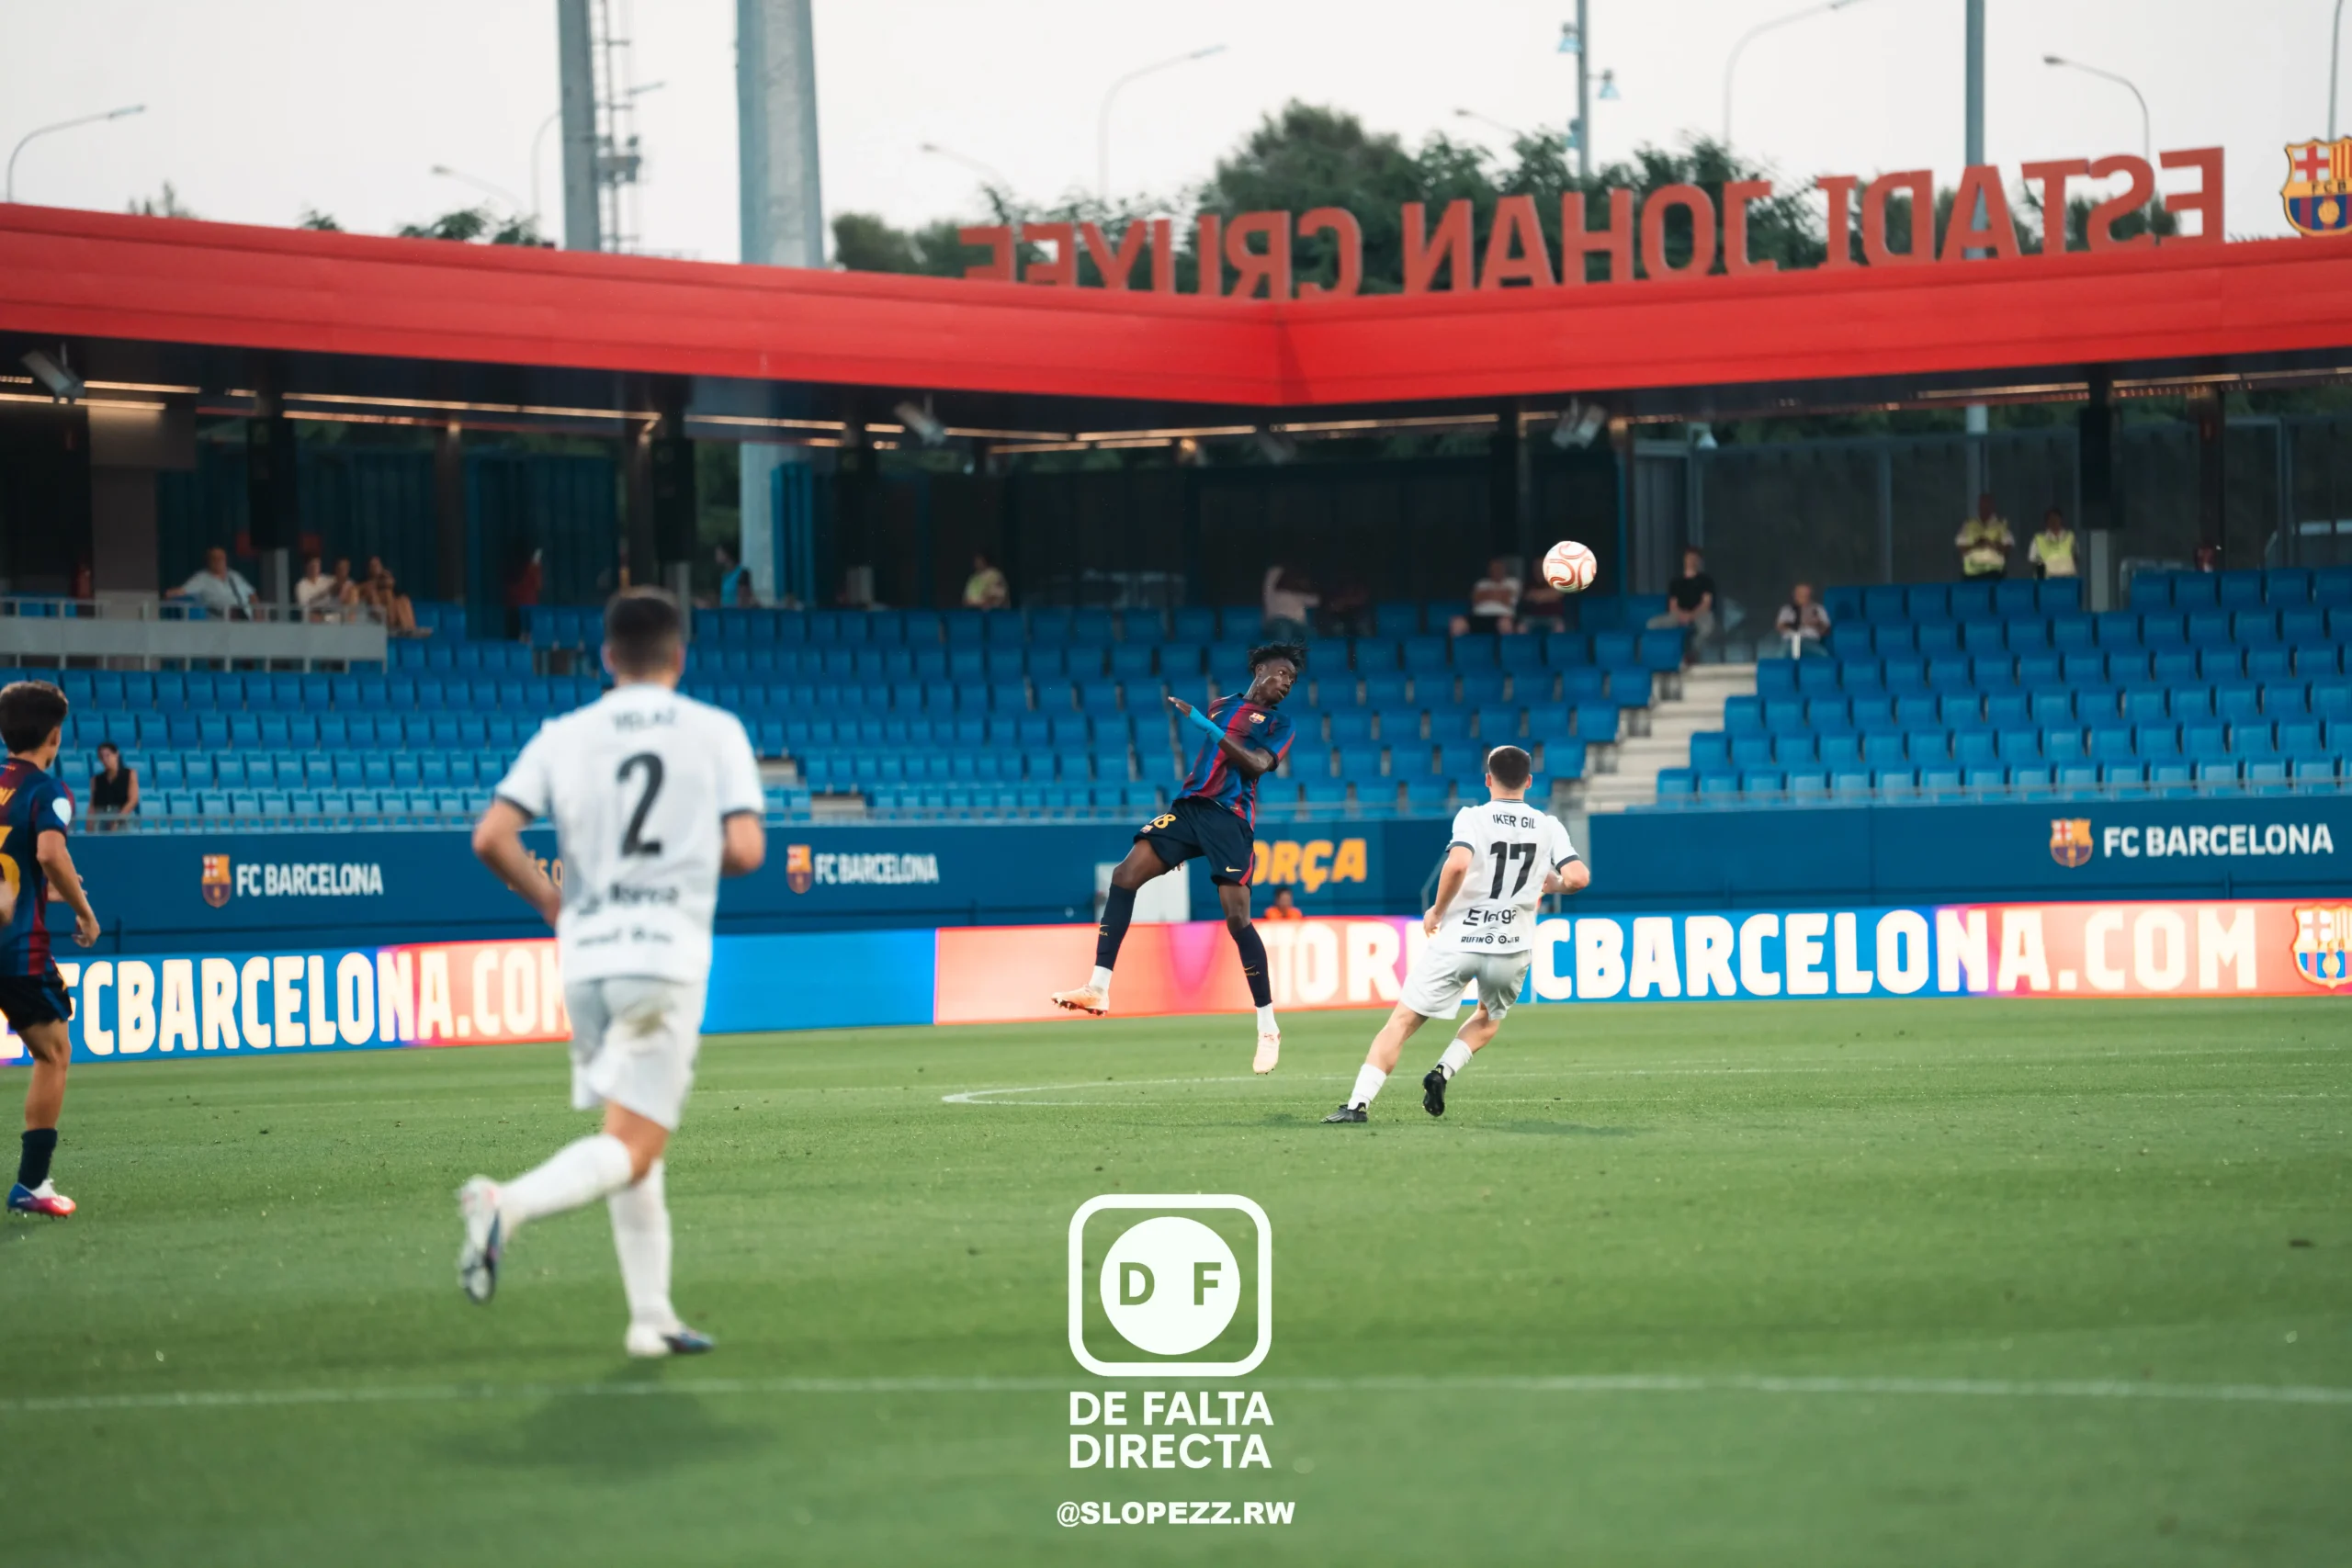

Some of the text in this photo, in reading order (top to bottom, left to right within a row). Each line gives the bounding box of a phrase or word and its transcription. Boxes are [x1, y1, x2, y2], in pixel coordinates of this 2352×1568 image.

[616, 750, 664, 858] 2
[1492, 814, 1537, 829] IKER GIL
[2103, 823, 2335, 858] FC BARCELONA
[236, 863, 384, 897] FC BARCELONA
[814, 852, 940, 885] FC BARCELONA
[1488, 840, 1537, 899] 17
